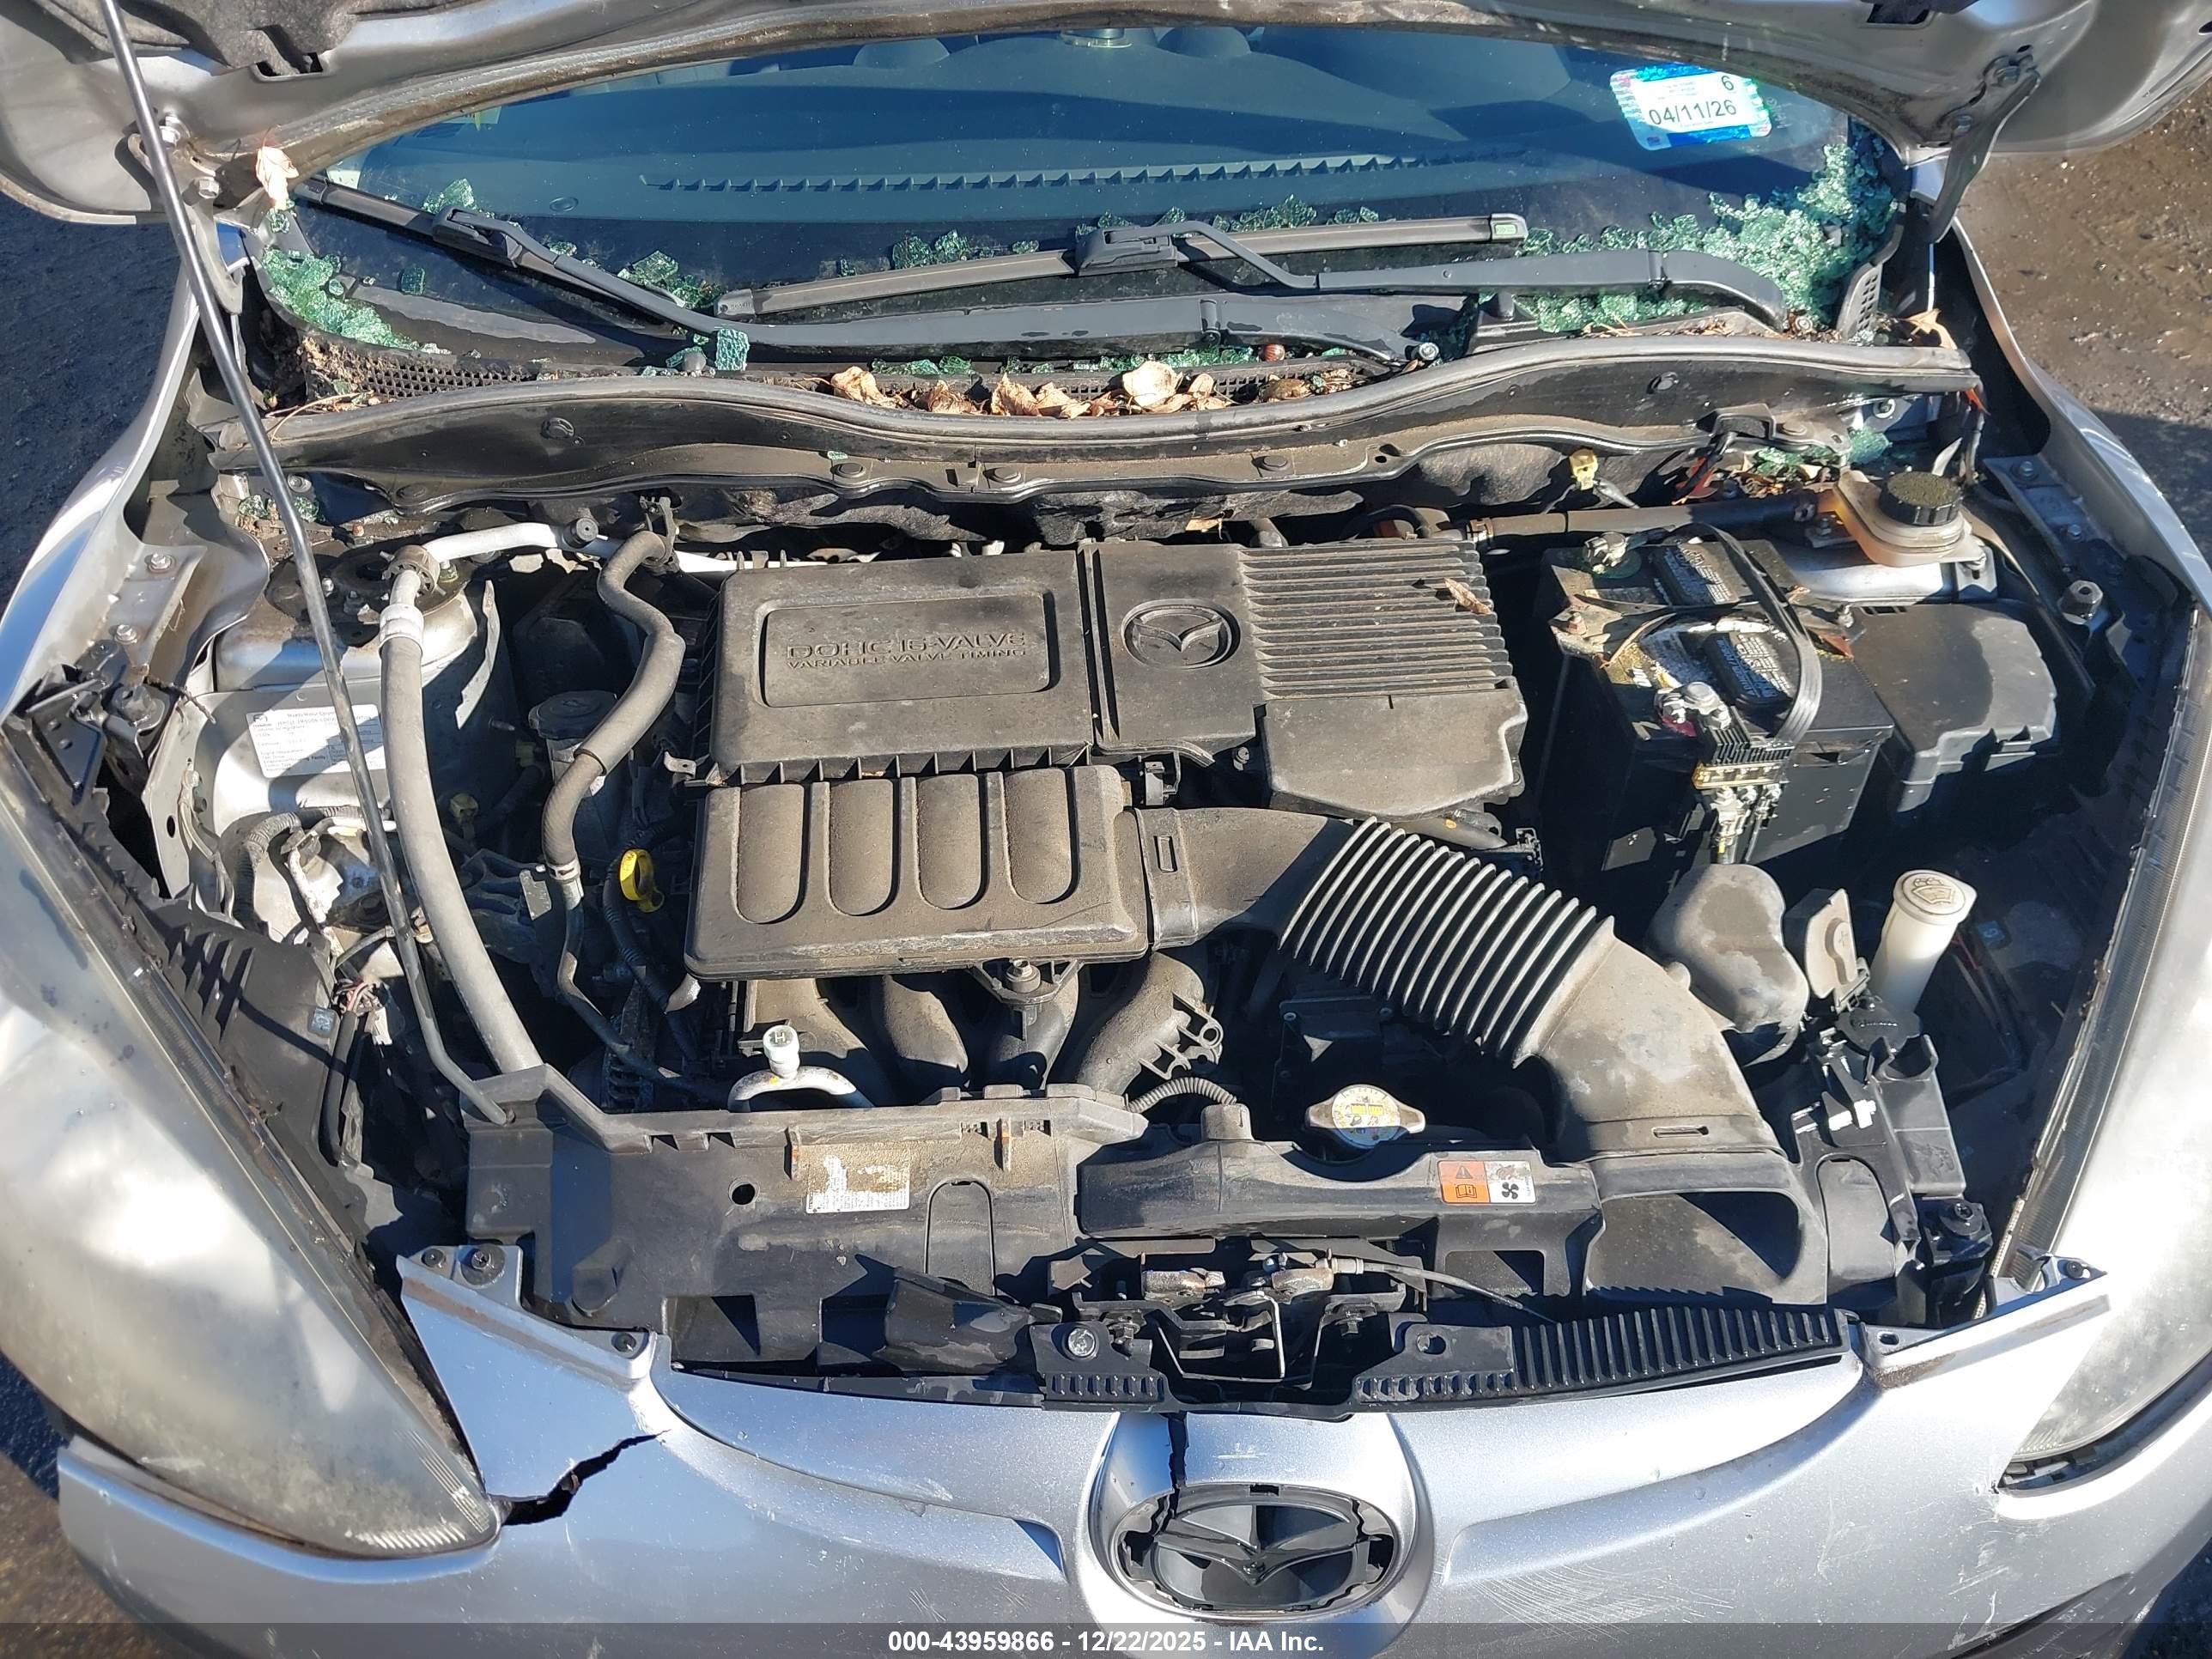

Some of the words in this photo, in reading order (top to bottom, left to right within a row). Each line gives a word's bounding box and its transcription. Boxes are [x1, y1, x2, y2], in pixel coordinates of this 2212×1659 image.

[1722, 76, 1734, 90] 6
[1649, 100, 1736, 125] 04/11/26
[787, 639, 892, 659] DOHC
[787, 656, 886, 669] VARIABLE
[892, 653, 952, 663] VALVE
[958, 648, 1026, 659] TIMING
